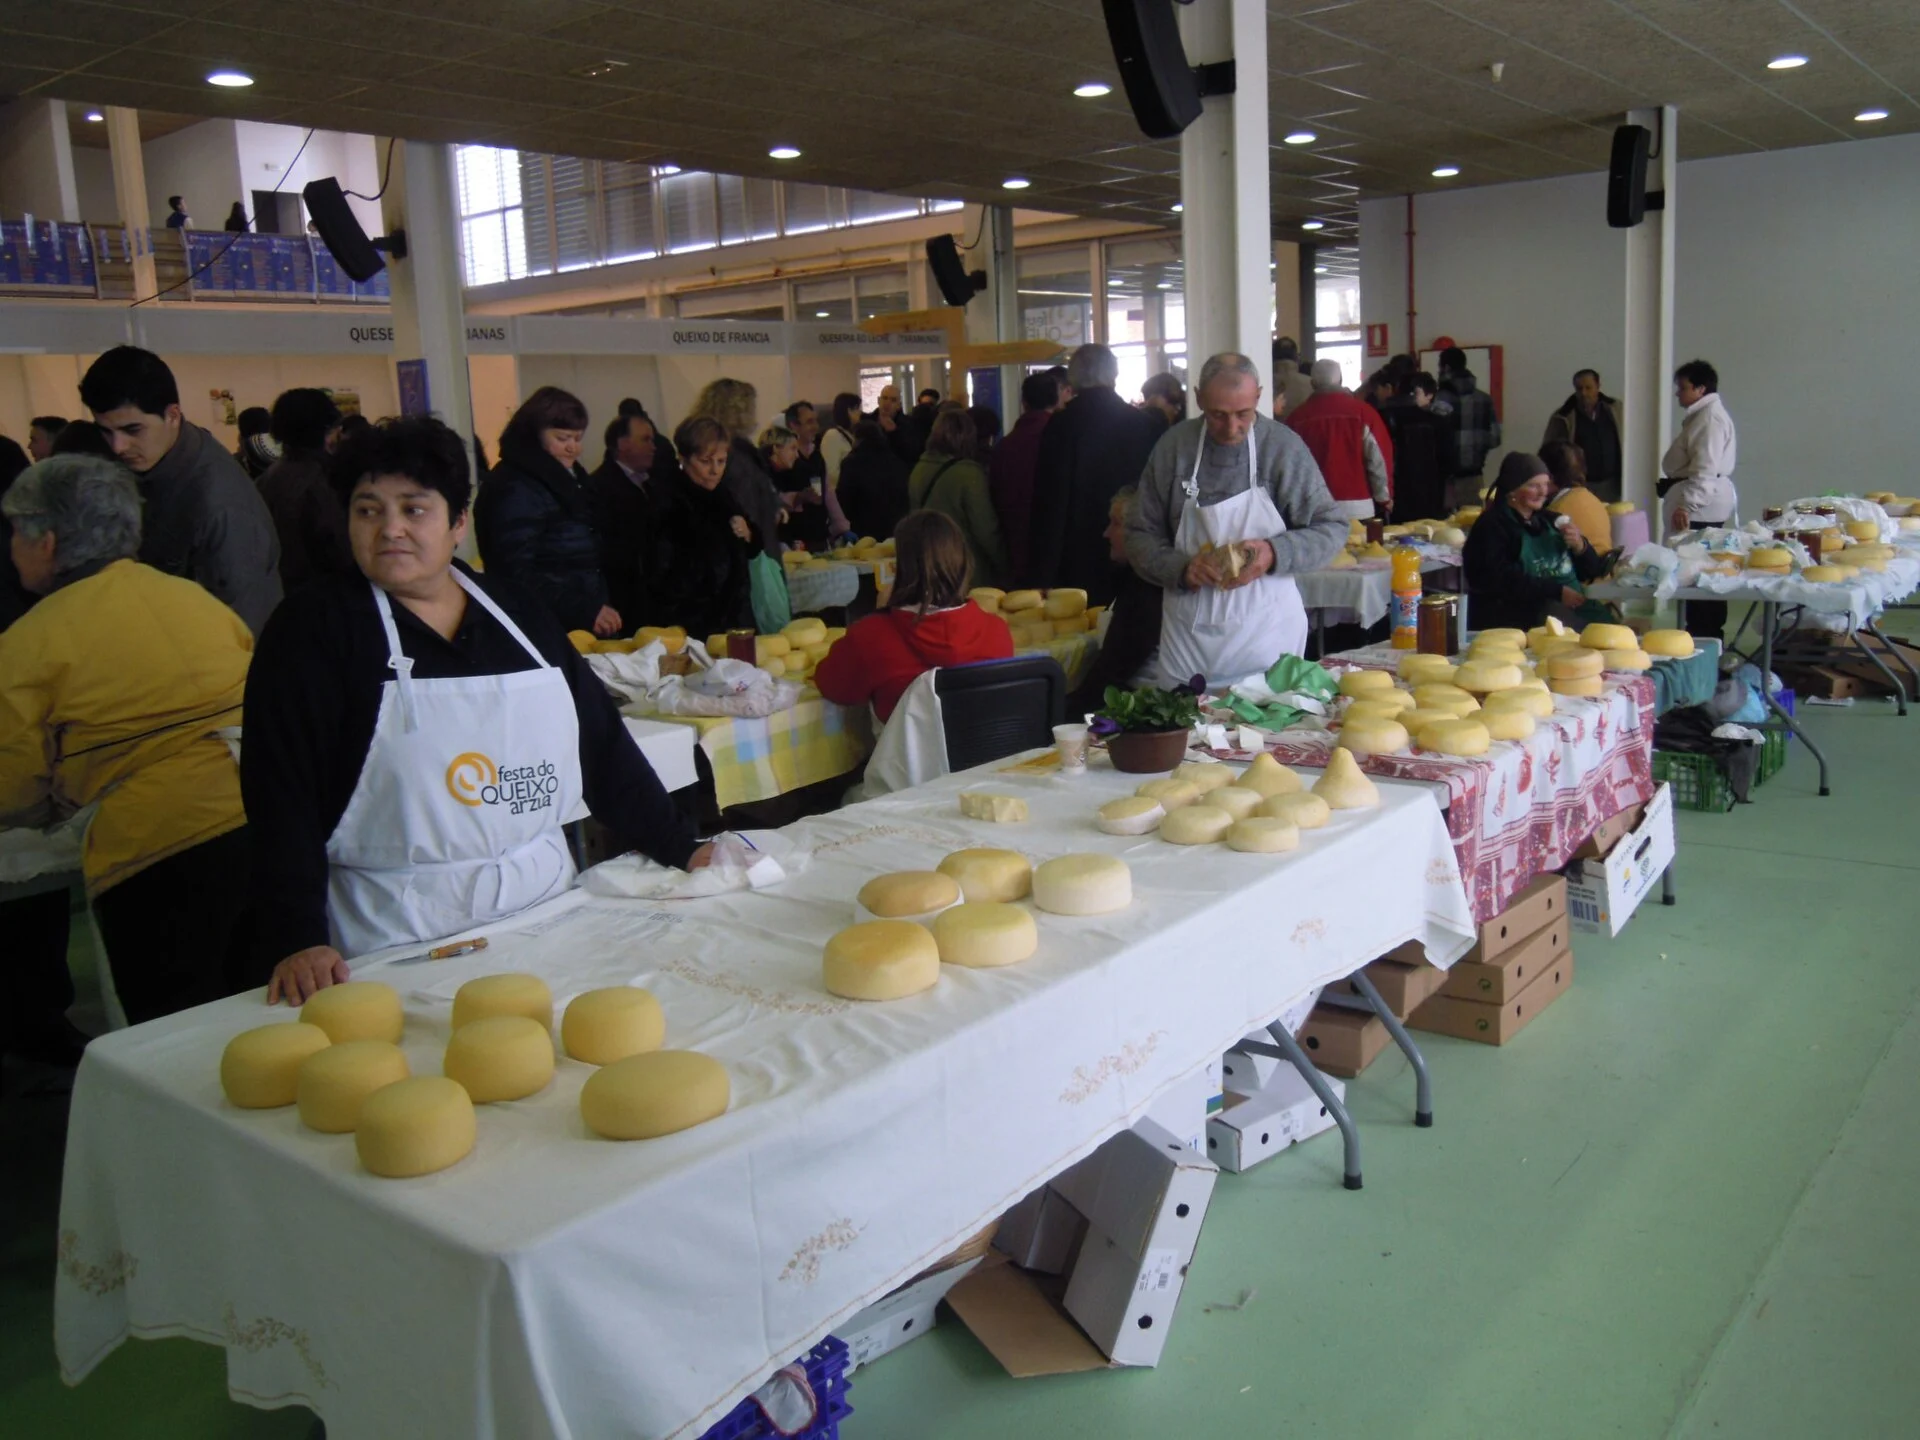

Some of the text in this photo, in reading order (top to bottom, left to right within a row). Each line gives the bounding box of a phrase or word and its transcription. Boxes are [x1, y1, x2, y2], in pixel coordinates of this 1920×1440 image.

[673, 331, 770, 344] QUEIXO DE FRANCIA
[498, 760, 555, 783] festa do
[481, 776, 559, 805] QUEIXO
